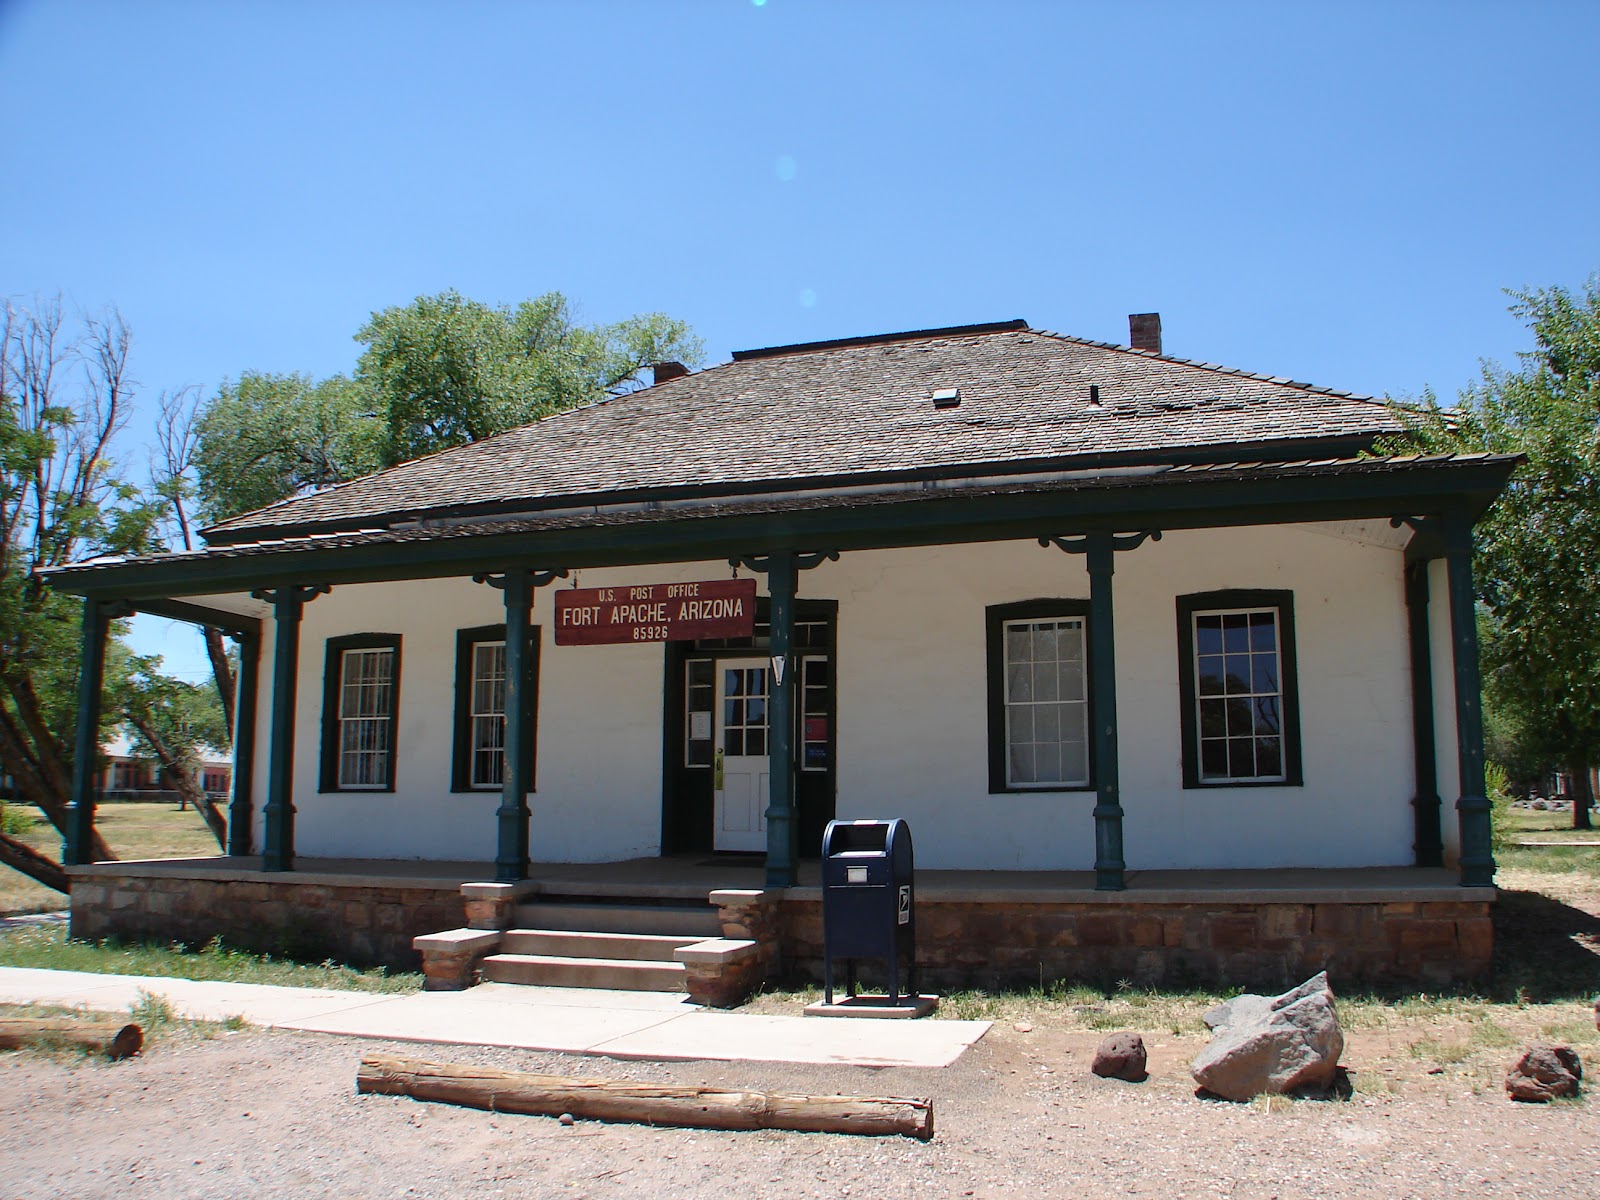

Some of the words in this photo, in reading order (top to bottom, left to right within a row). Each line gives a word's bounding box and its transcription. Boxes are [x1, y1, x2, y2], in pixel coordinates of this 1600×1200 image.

[599, 589, 617, 602] U.S.
[630, 586, 654, 600] POST
[667, 583, 699, 599] OFFICE
[562, 606, 601, 626] FORT
[610, 602, 672, 625] APACHE,
[678, 598, 743, 621] ARIZONA
[633, 625, 668, 640] 85926
